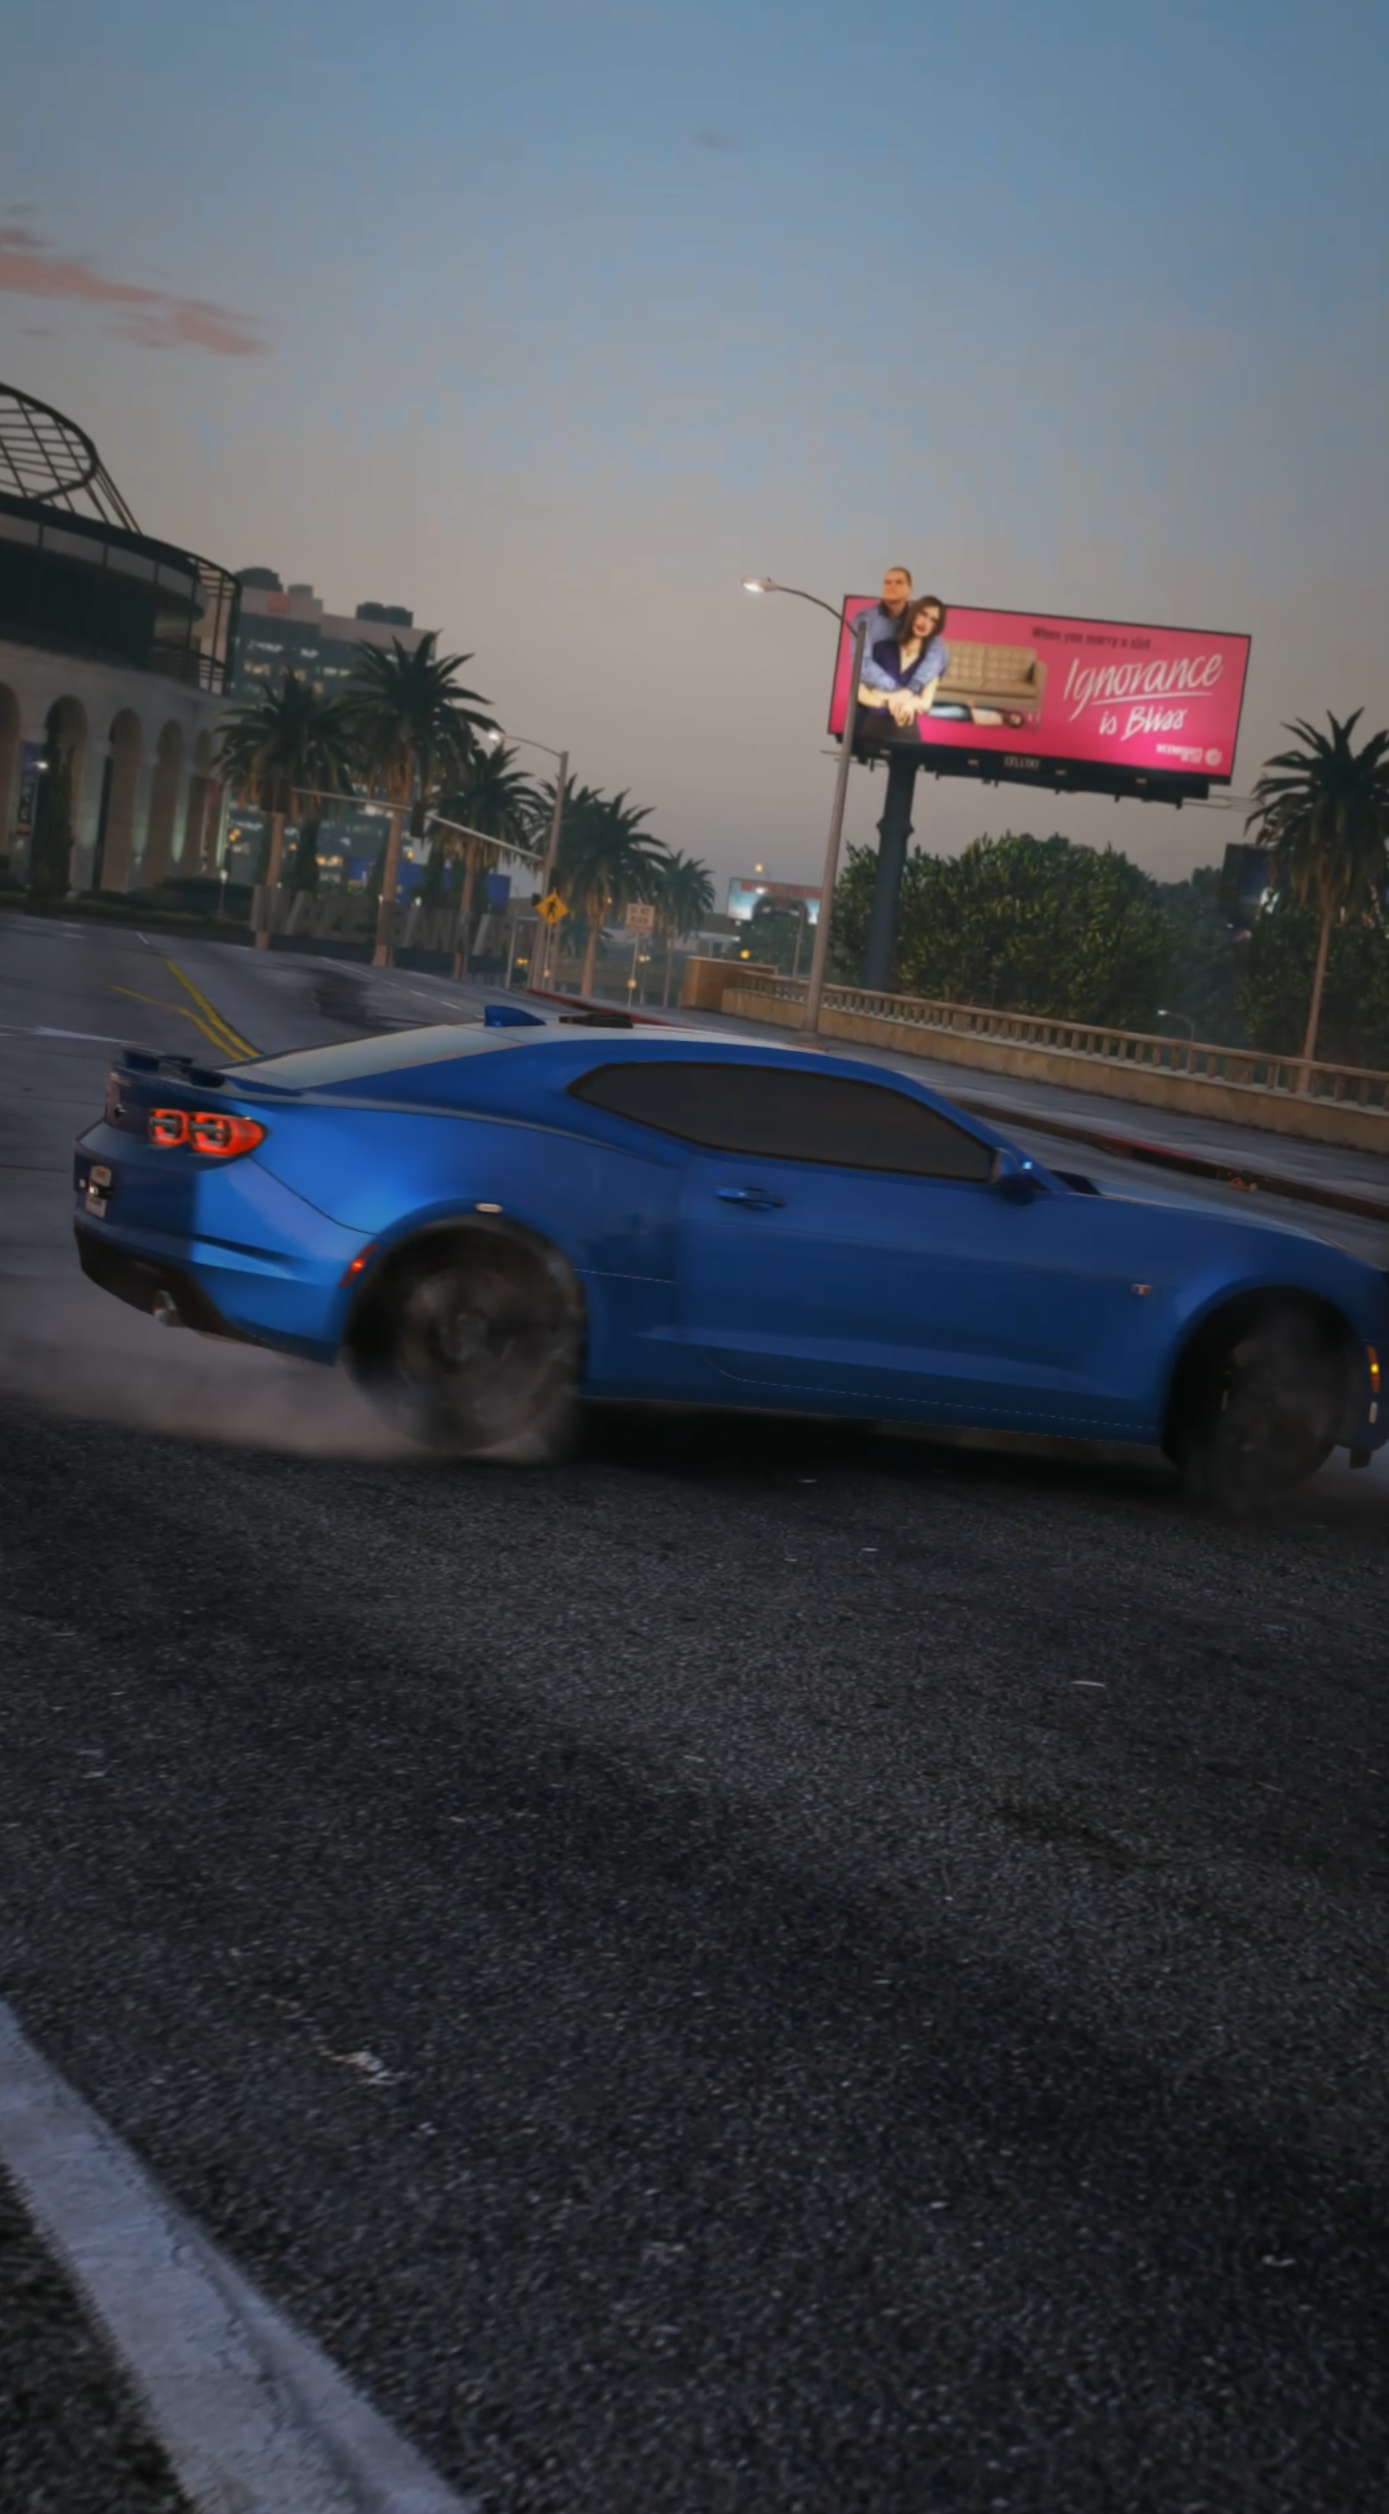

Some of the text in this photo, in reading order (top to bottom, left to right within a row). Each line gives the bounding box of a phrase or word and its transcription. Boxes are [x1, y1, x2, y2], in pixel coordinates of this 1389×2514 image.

[1031, 625, 1061, 640] When
[1064, 632, 1083, 645] you
[1063, 653, 1224, 722] Ignorance
[1098, 705, 1188, 742] is Bliss
